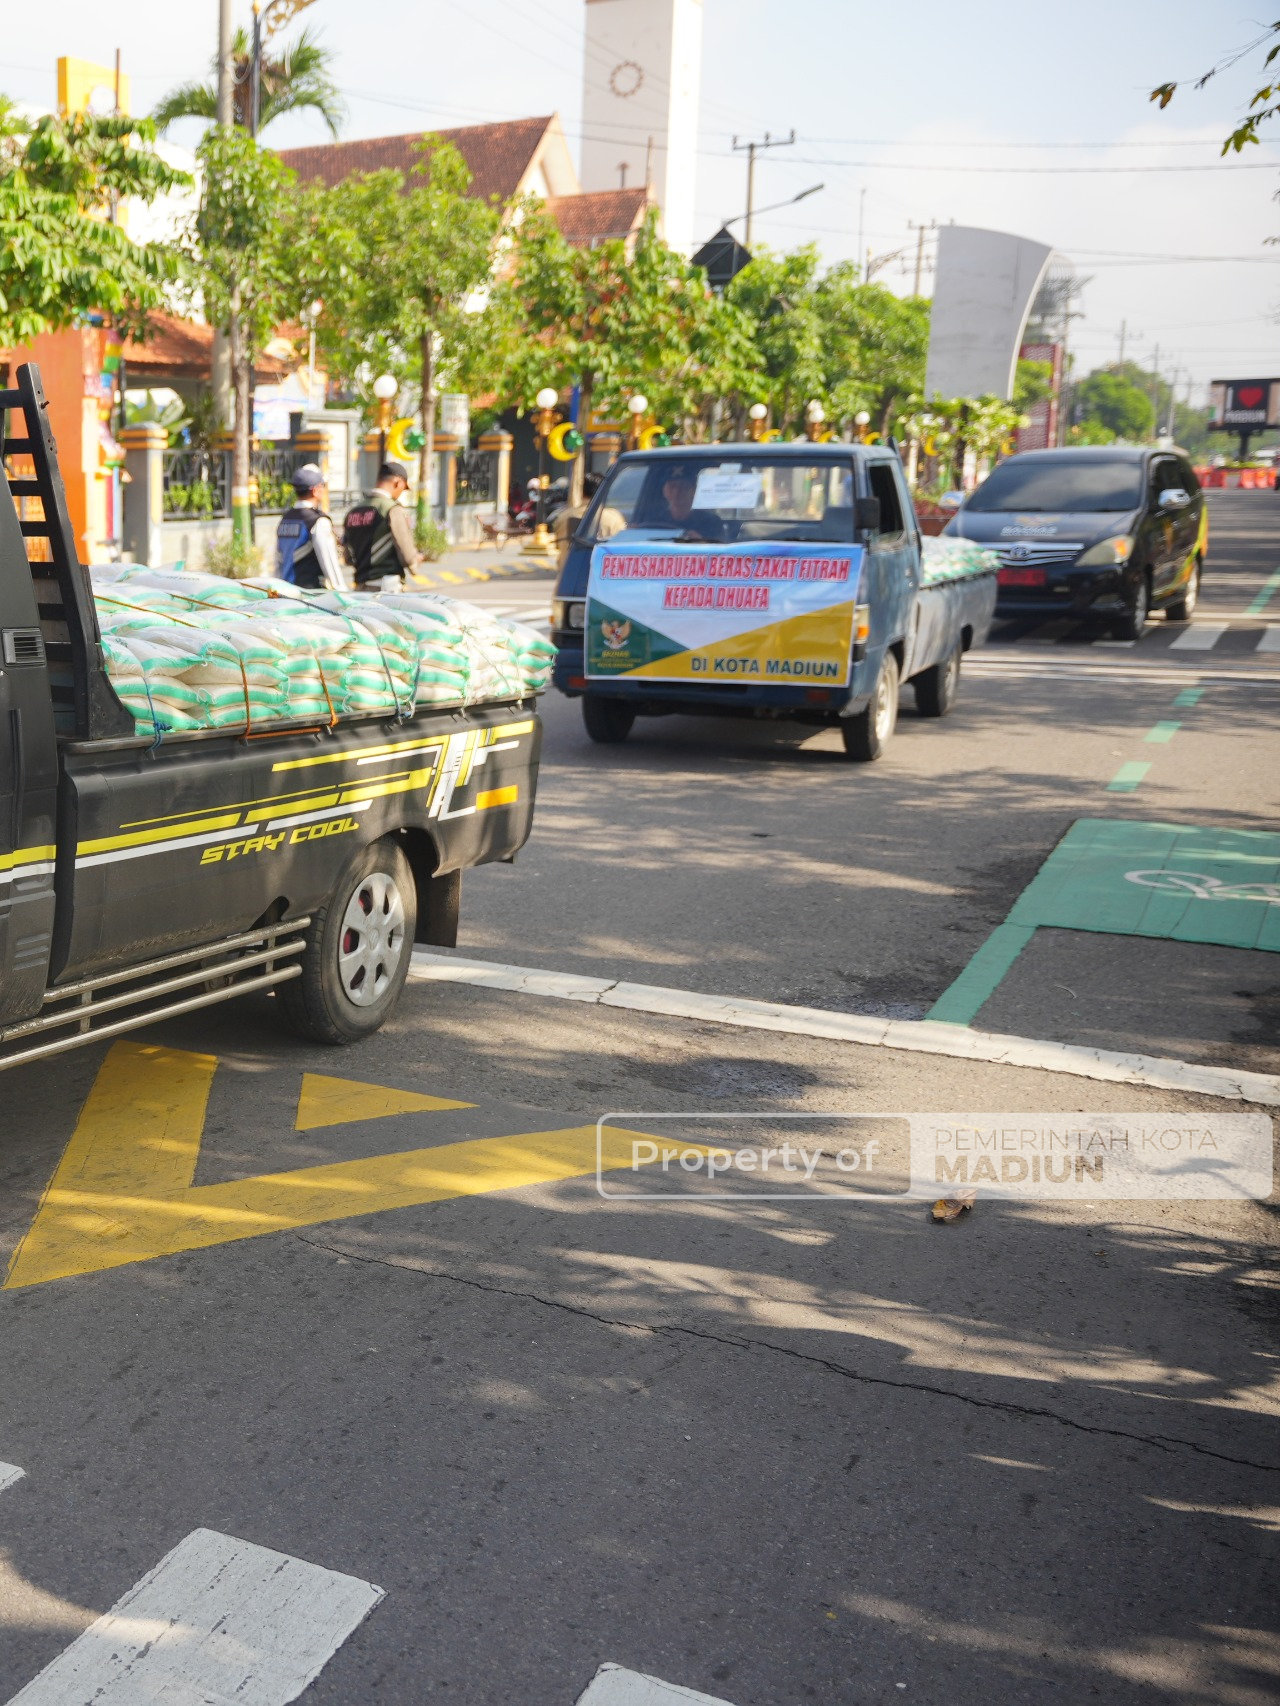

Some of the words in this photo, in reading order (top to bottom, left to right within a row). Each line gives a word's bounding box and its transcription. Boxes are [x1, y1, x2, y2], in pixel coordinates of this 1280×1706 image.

[601, 554, 708, 580] PENTASHARUFAN
[708, 556, 753, 580] BERAS
[753, 557, 798, 581] ZAKAT
[798, 558, 851, 581] FITRAH
[663, 585, 715, 610] KEPADA
[714, 585, 770, 611] DHUAFA
[691, 657, 708, 672] DI
[714, 658, 760, 674] KOTA
[765, 660, 839, 678] MADIUN
[200, 832, 286, 865] STAY
[289, 818, 360, 845] COOL
